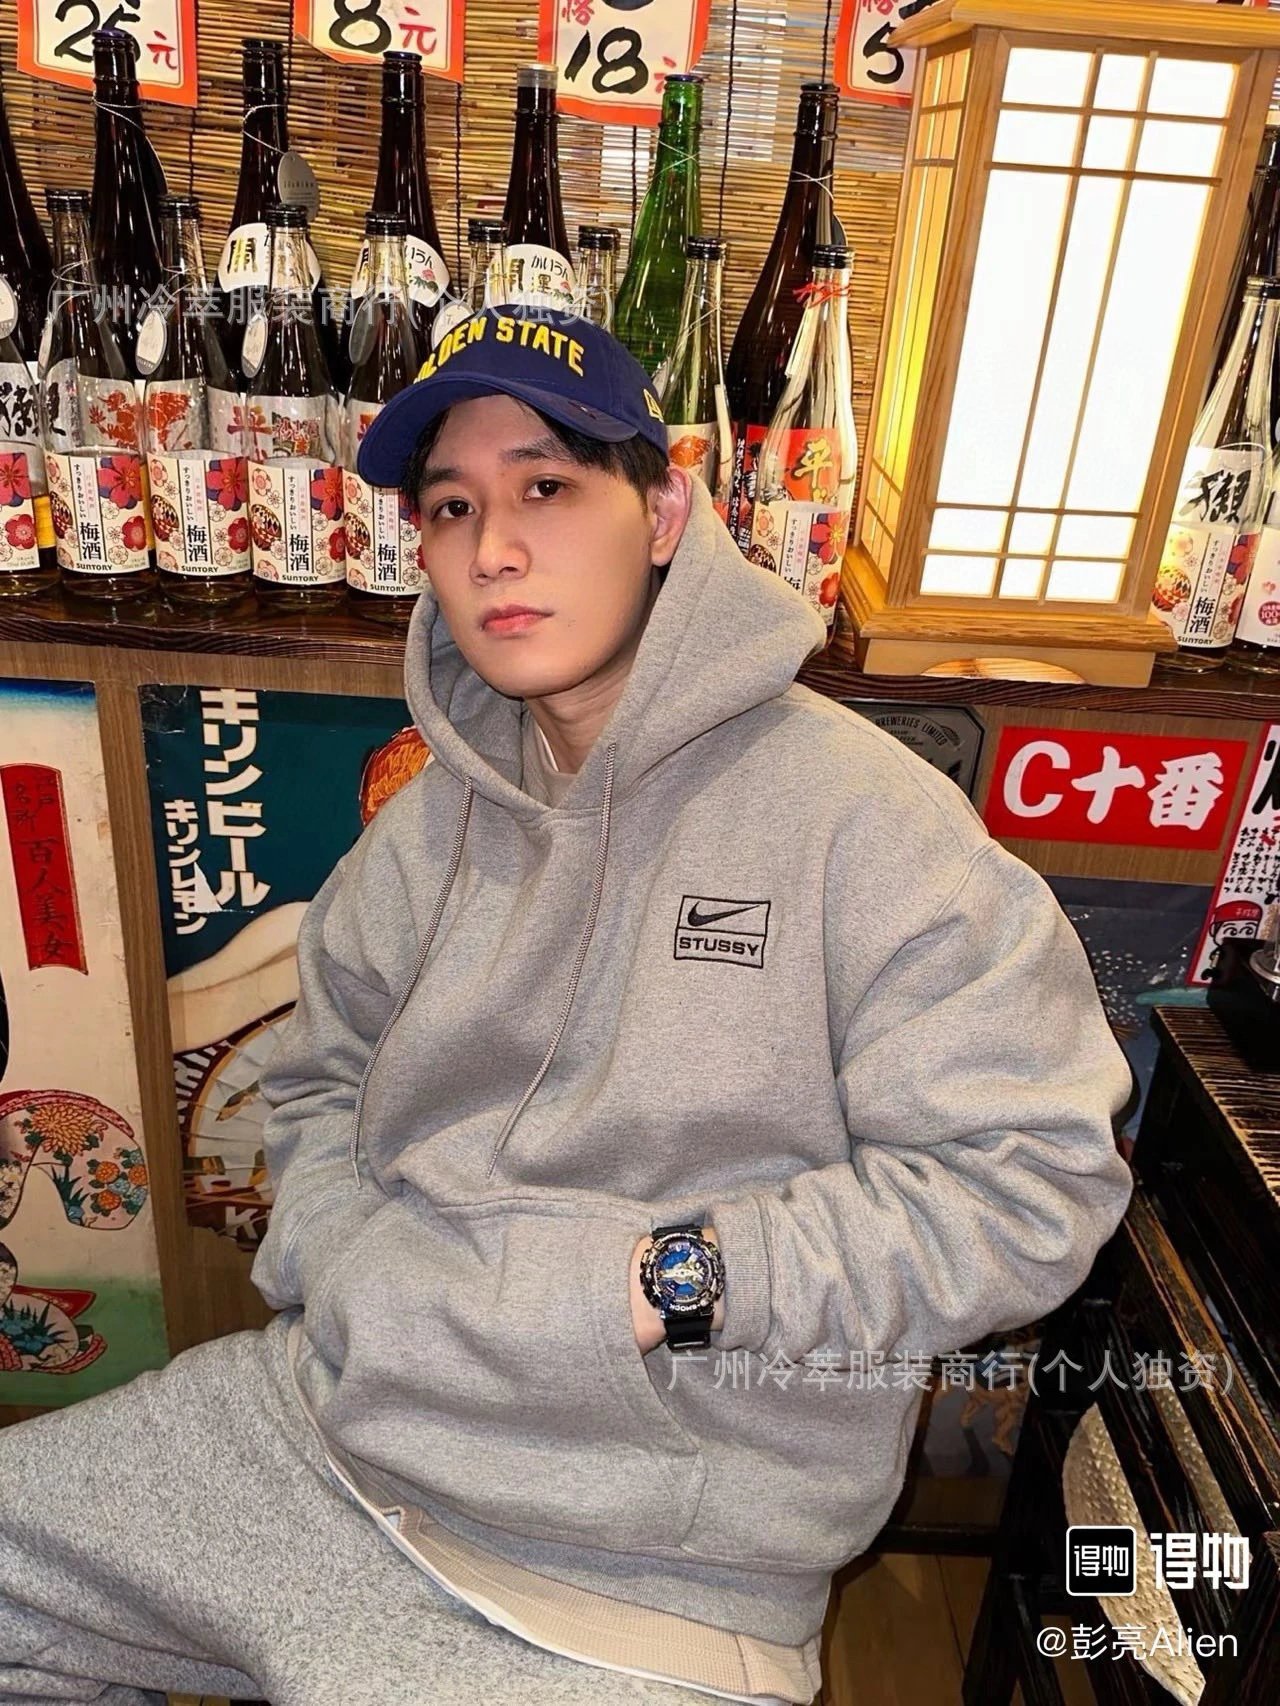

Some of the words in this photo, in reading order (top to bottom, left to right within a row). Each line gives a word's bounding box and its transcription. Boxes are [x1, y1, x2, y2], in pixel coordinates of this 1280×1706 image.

[397, 6, 438, 55] 元
[146, 30, 178, 70] 元
[564, 27, 649, 94] 18
[413, 317, 488, 384] OLDEN
[496, 317, 586, 377] STATE
[80, 522, 101, 560] 梅酒
[187, 524, 208, 562] 梅酒
[289, 534, 310, 571] 梅酒
[76, 562, 112, 571] SUNTORY
[181, 565, 219, 573] SUNTORY
[282, 574, 319, 582] SUNTORY
[378, 543, 397, 581] 梅酒
[370, 583, 406, 593] SUNTORY
[1189, 596, 1216, 633] 梅酒
[921, 722, 948, 747] LIMITED
[201, 688, 271, 907] キリンビール
[1003, 740, 1224, 831] C十番
[679, 936, 759, 957] STUSSY
